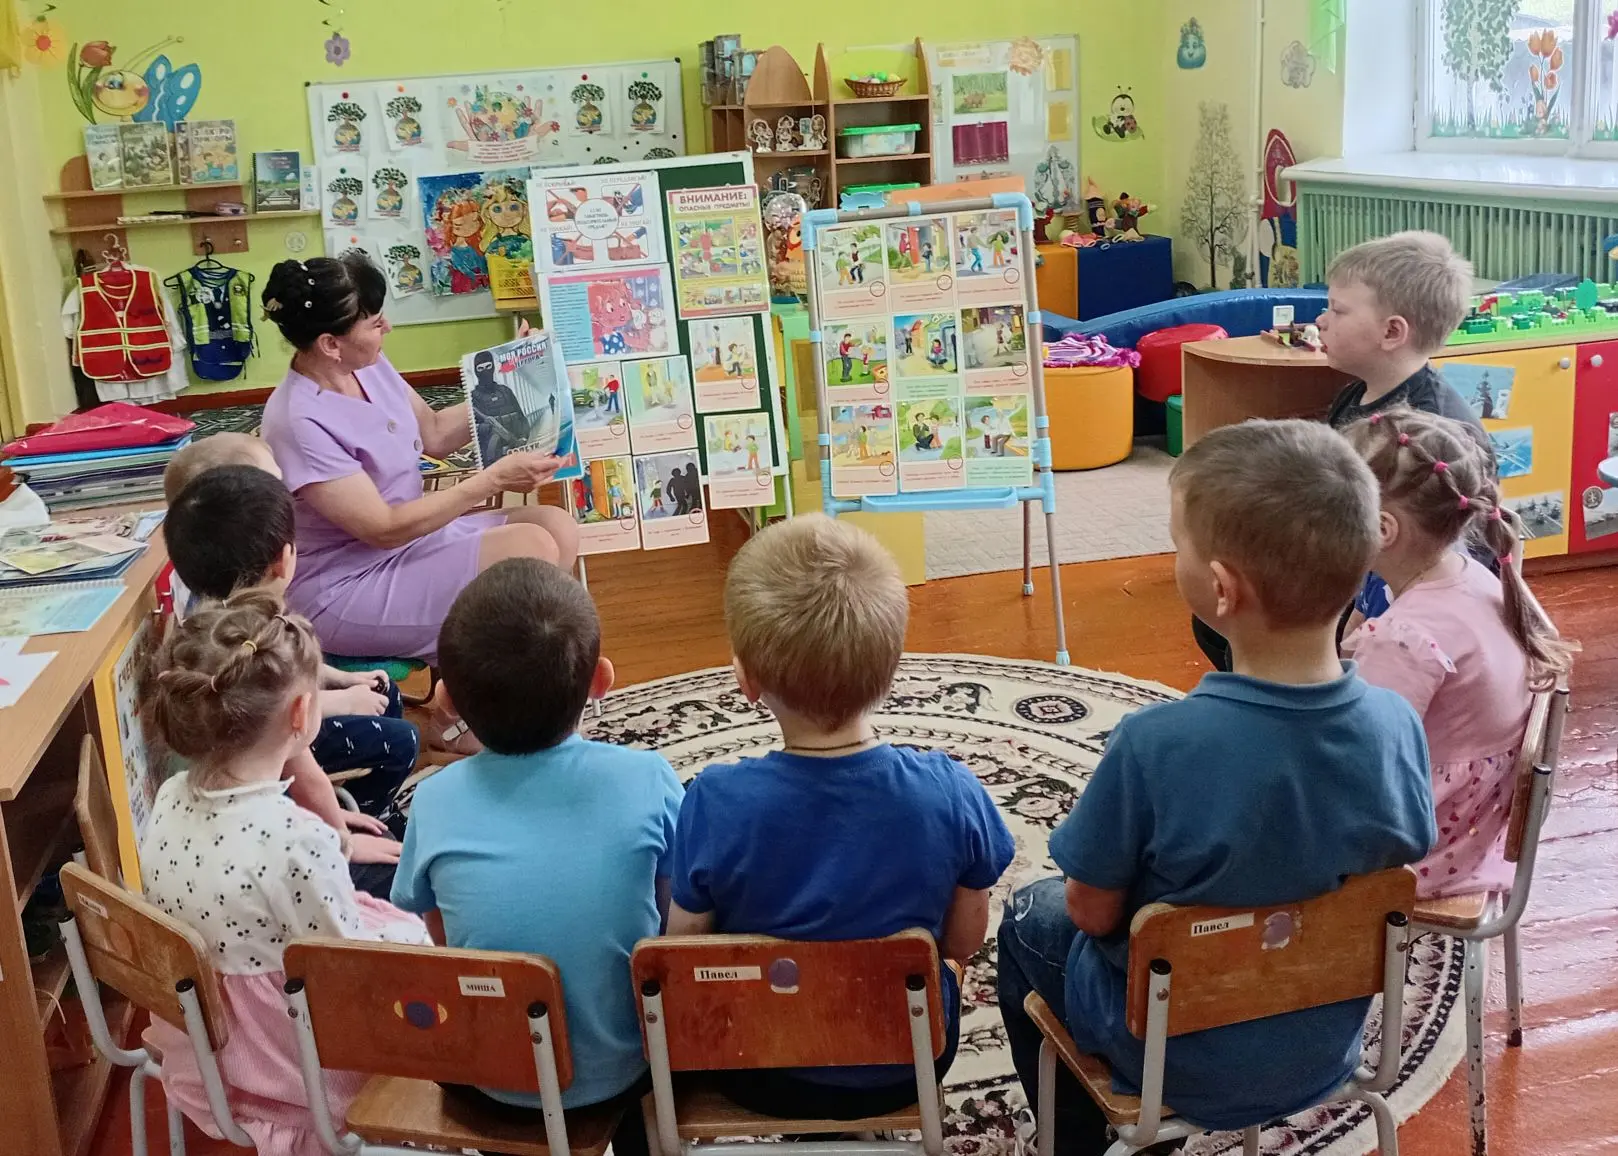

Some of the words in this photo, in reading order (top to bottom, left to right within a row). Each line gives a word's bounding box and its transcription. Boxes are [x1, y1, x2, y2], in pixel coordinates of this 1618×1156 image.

[679, 204, 712, 212] ОПАСНЫЕ
[517, 341, 547, 358] РОССИЯ
[1193, 922, 1230, 934] Павел
[700, 970, 738, 979] Павел
